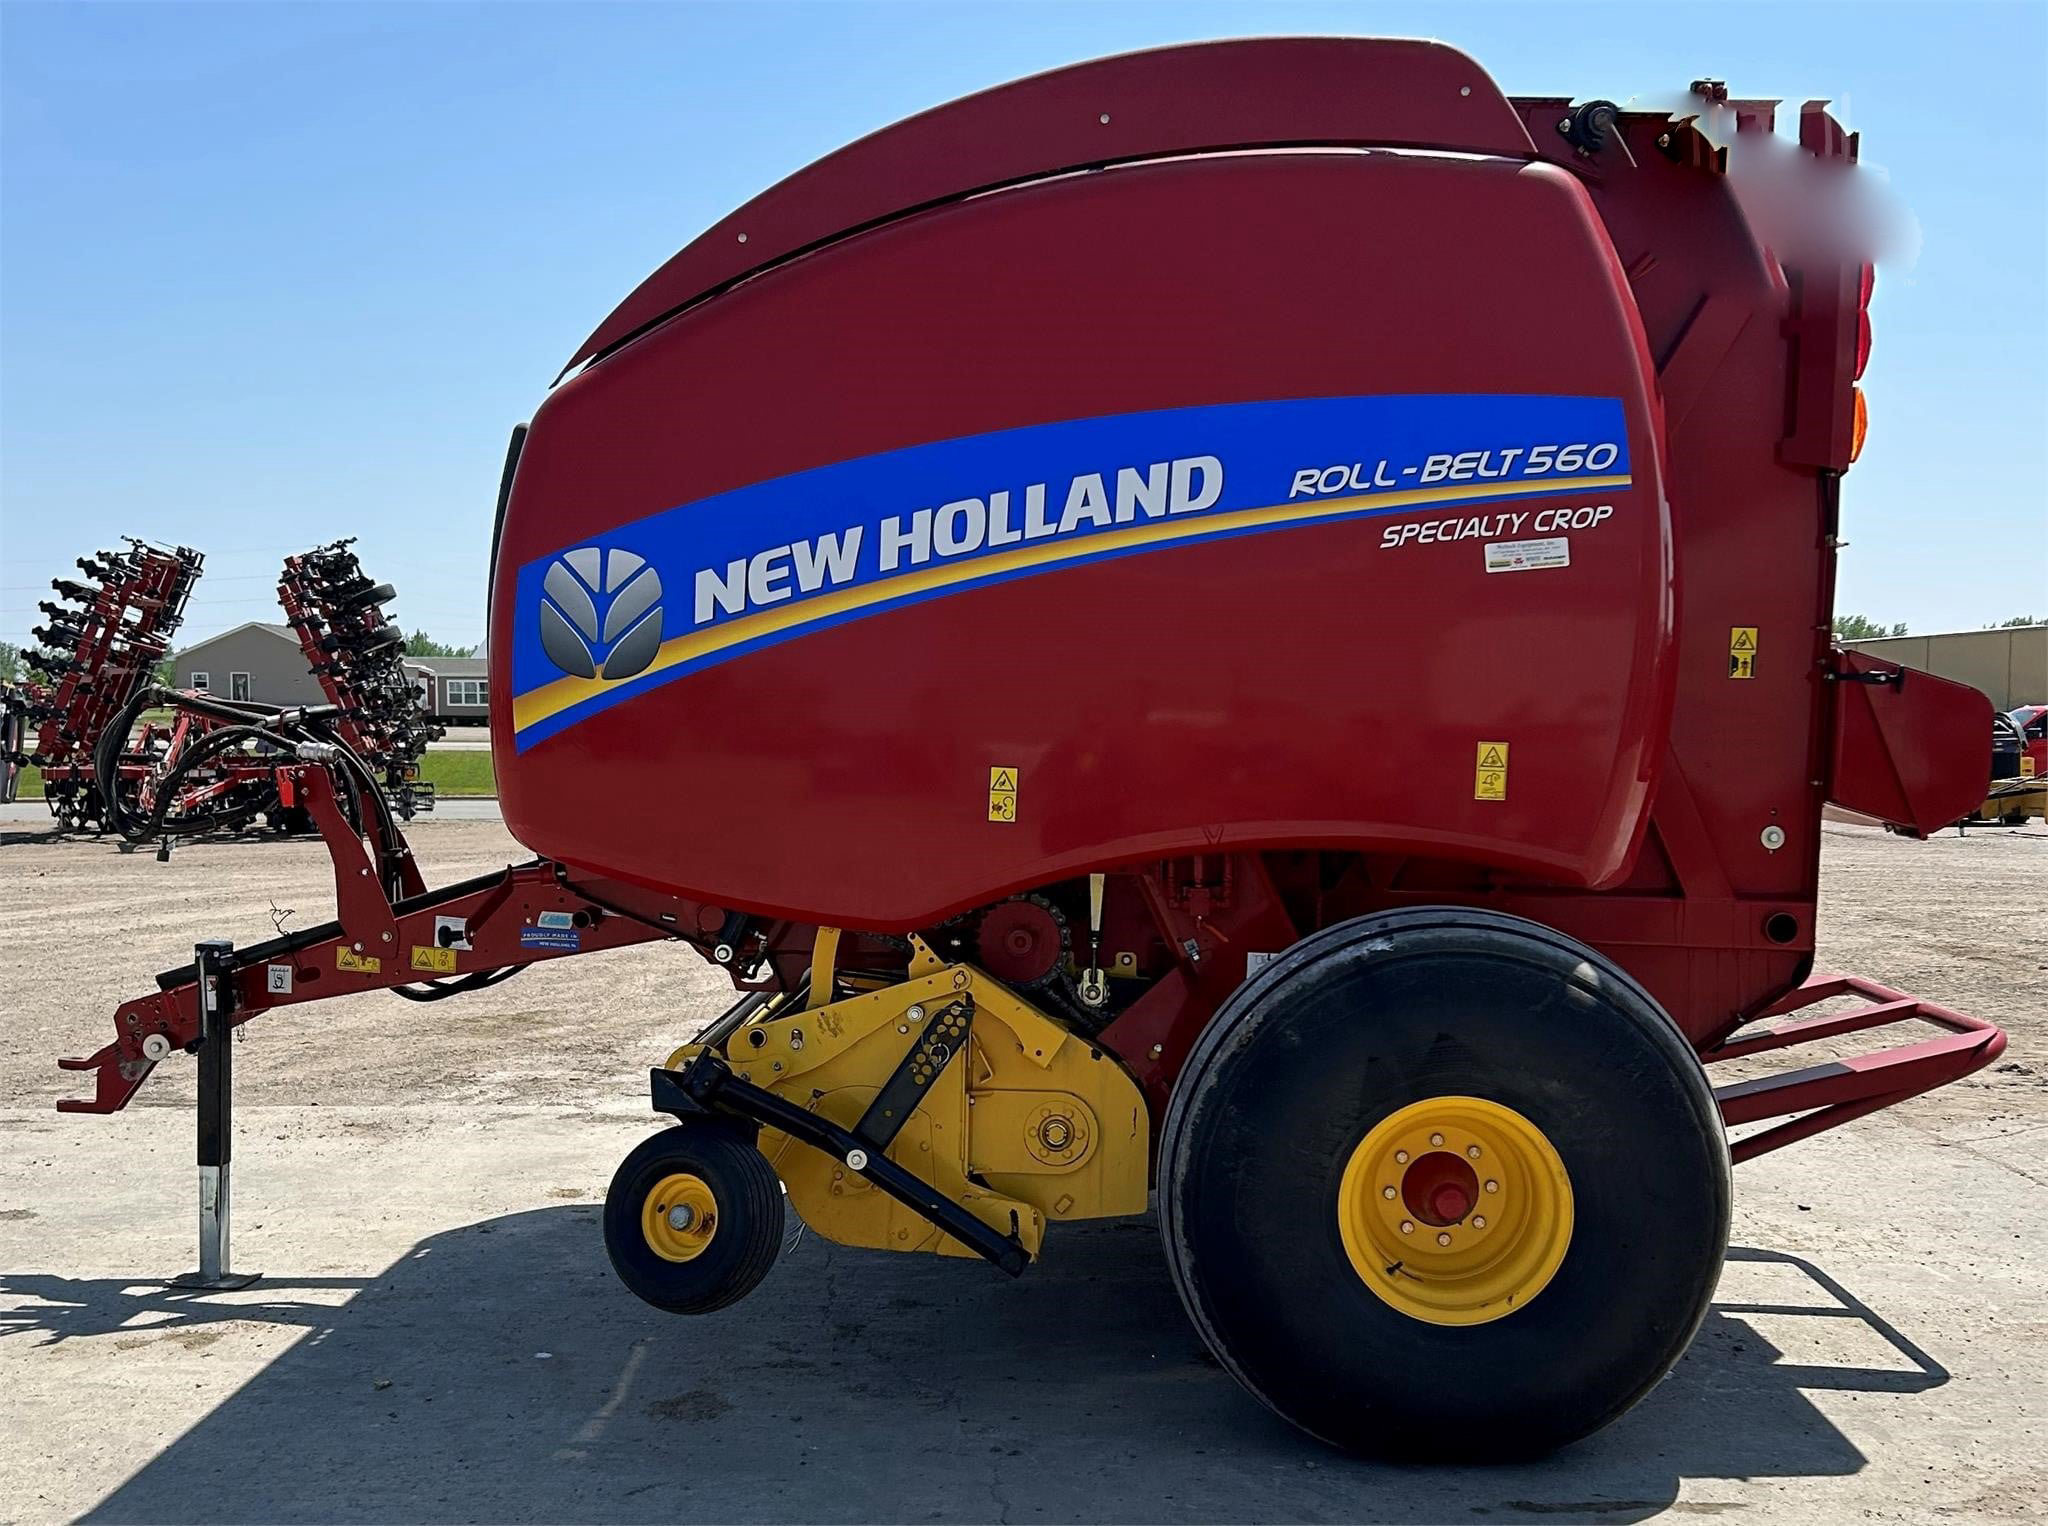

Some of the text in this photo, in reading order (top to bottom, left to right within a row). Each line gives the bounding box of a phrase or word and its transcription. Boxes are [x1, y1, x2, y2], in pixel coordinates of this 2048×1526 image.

[1524, 443, 1619, 475] 560
[694, 455, 1223, 625] NEW HOLLAND
[1380, 506, 1614, 549] SPECIALTY CROP
